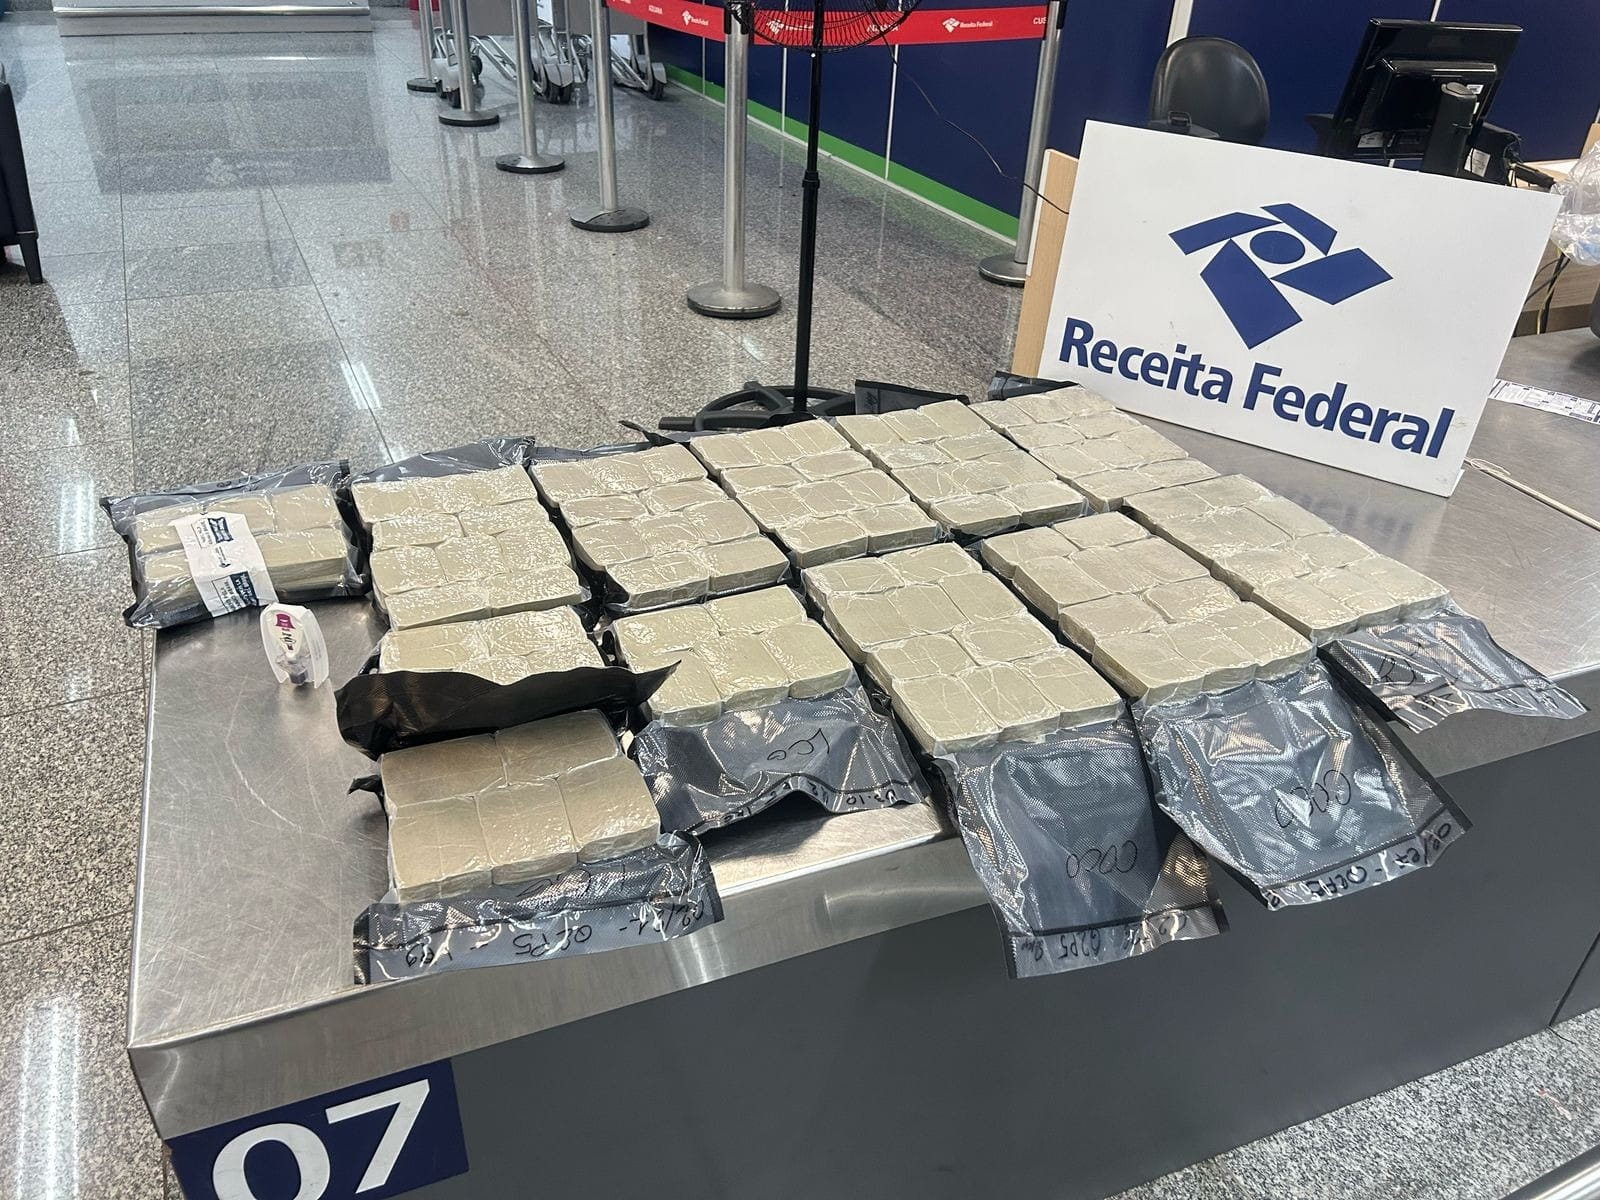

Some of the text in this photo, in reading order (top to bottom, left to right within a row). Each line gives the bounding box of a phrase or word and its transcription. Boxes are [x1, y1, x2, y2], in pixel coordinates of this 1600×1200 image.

[1058, 317, 1234, 404] Receita
[1242, 361, 1456, 459] Federal
[212, 1078, 431, 1200] 07
